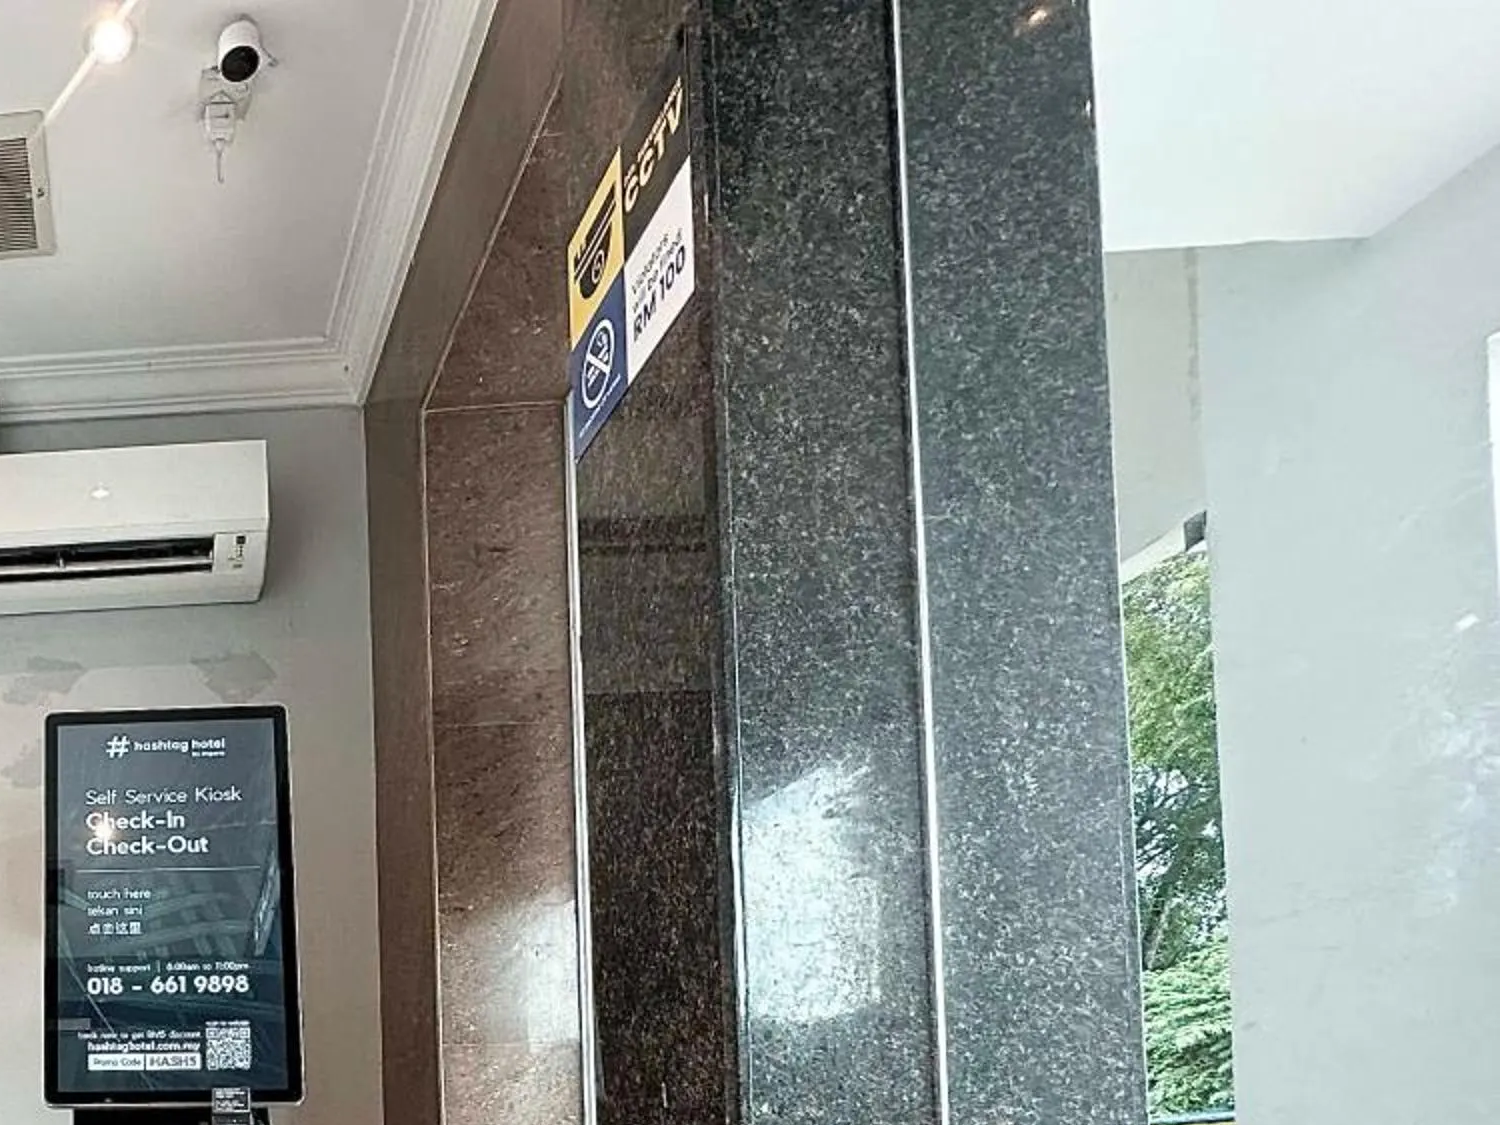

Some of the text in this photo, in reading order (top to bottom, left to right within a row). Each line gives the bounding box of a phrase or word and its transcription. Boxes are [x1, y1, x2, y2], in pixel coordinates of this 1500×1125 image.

[625, 86, 683, 212] CCTV
[633, 245, 686, 341] RM 100
[133, 739, 188, 752] hashtag
[191, 737, 226, 749] hotel
[85, 785, 243, 805] Self Service Kiosk
[85, 810, 185, 830] Check-In
[86, 835, 209, 855] Check-Out
[124, 887, 152, 899] here
[123, 904, 143, 915] sini
[87, 977, 123, 995] 018
[150, 975, 186, 994] 661
[194, 974, 249, 994] 9898
[120, 1056, 142, 1067] Code
